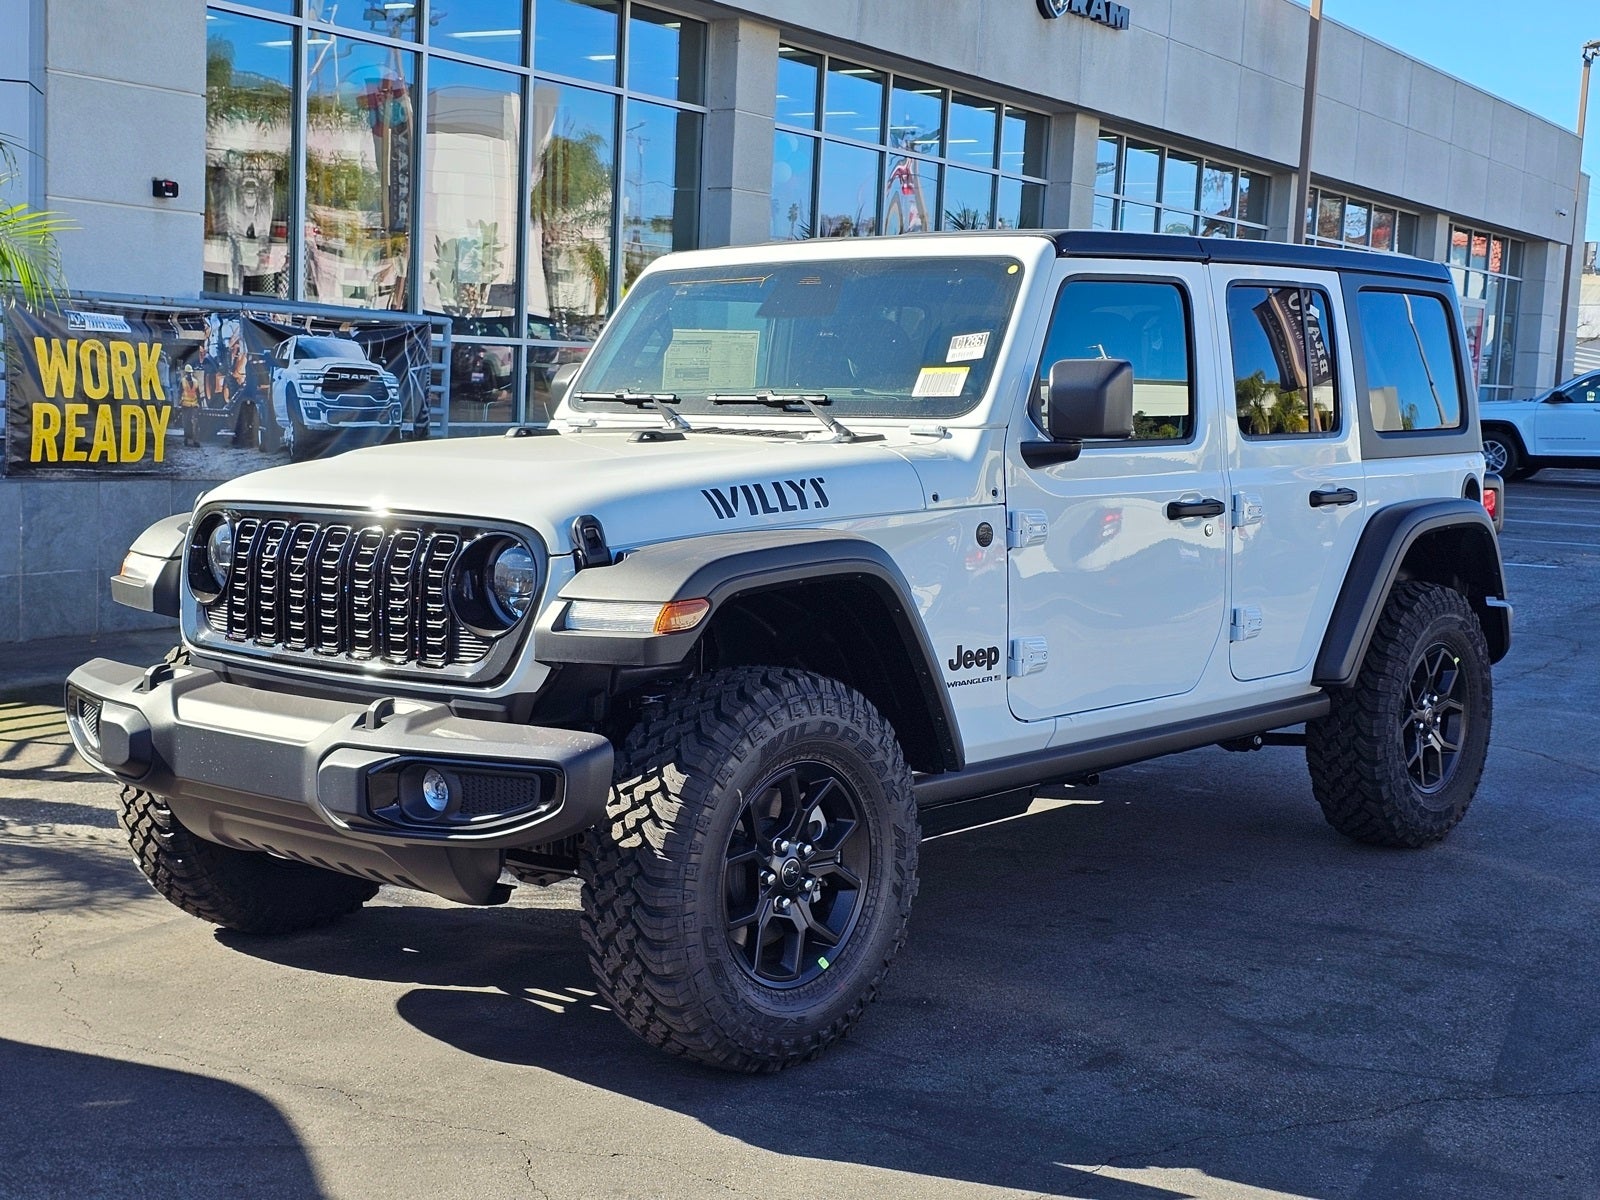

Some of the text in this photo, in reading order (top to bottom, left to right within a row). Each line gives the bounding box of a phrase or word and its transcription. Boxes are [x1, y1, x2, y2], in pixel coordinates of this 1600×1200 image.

[34, 336, 166, 400] WORK
[30, 402, 172, 463] READY
[700, 477, 830, 520] WILLYS
[946, 675, 993, 688] WRANGLER
[948, 644, 1000, 671] Jeep
[760, 720, 900, 804] WILDPEAK
